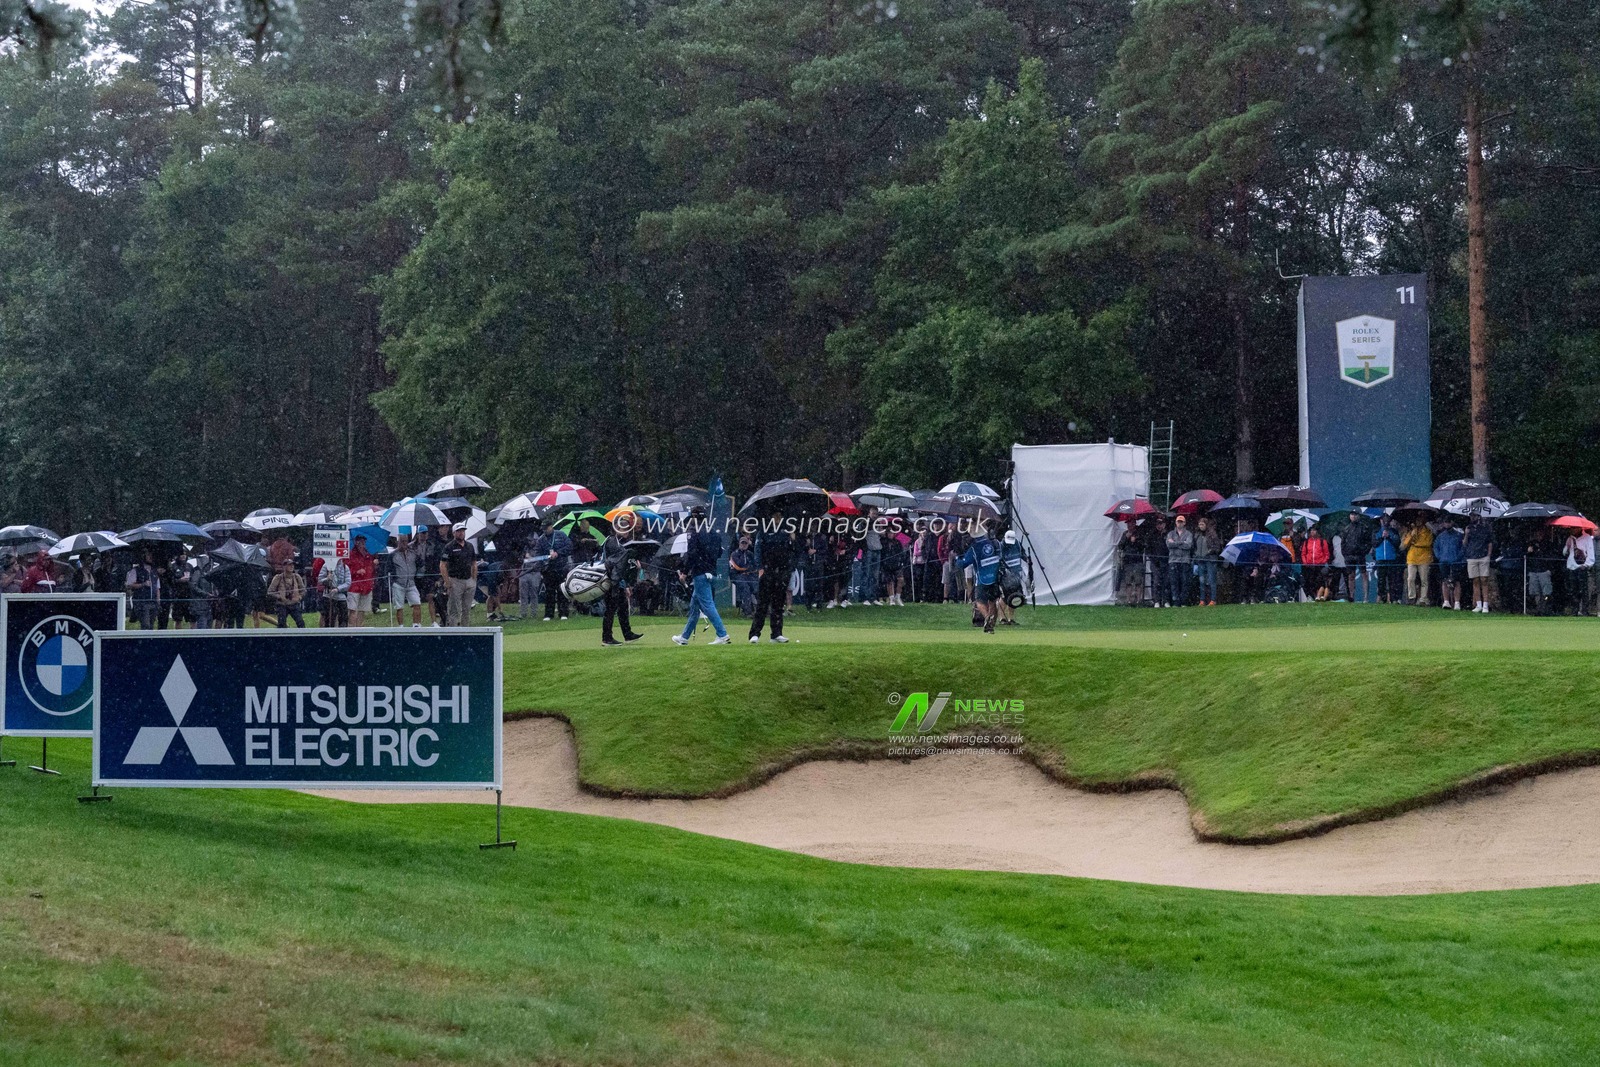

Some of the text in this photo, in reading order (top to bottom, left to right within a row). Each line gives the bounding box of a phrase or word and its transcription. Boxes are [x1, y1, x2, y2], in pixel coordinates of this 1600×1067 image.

[1396, 286, 1415, 304] 11
[1352, 336, 1381, 344] SERIES
[262, 516, 290, 526] PING
[31, 620, 94, 648] BMW
[245, 684, 470, 725] MITSUBISHI
[245, 727, 440, 768] ELECTRIC
